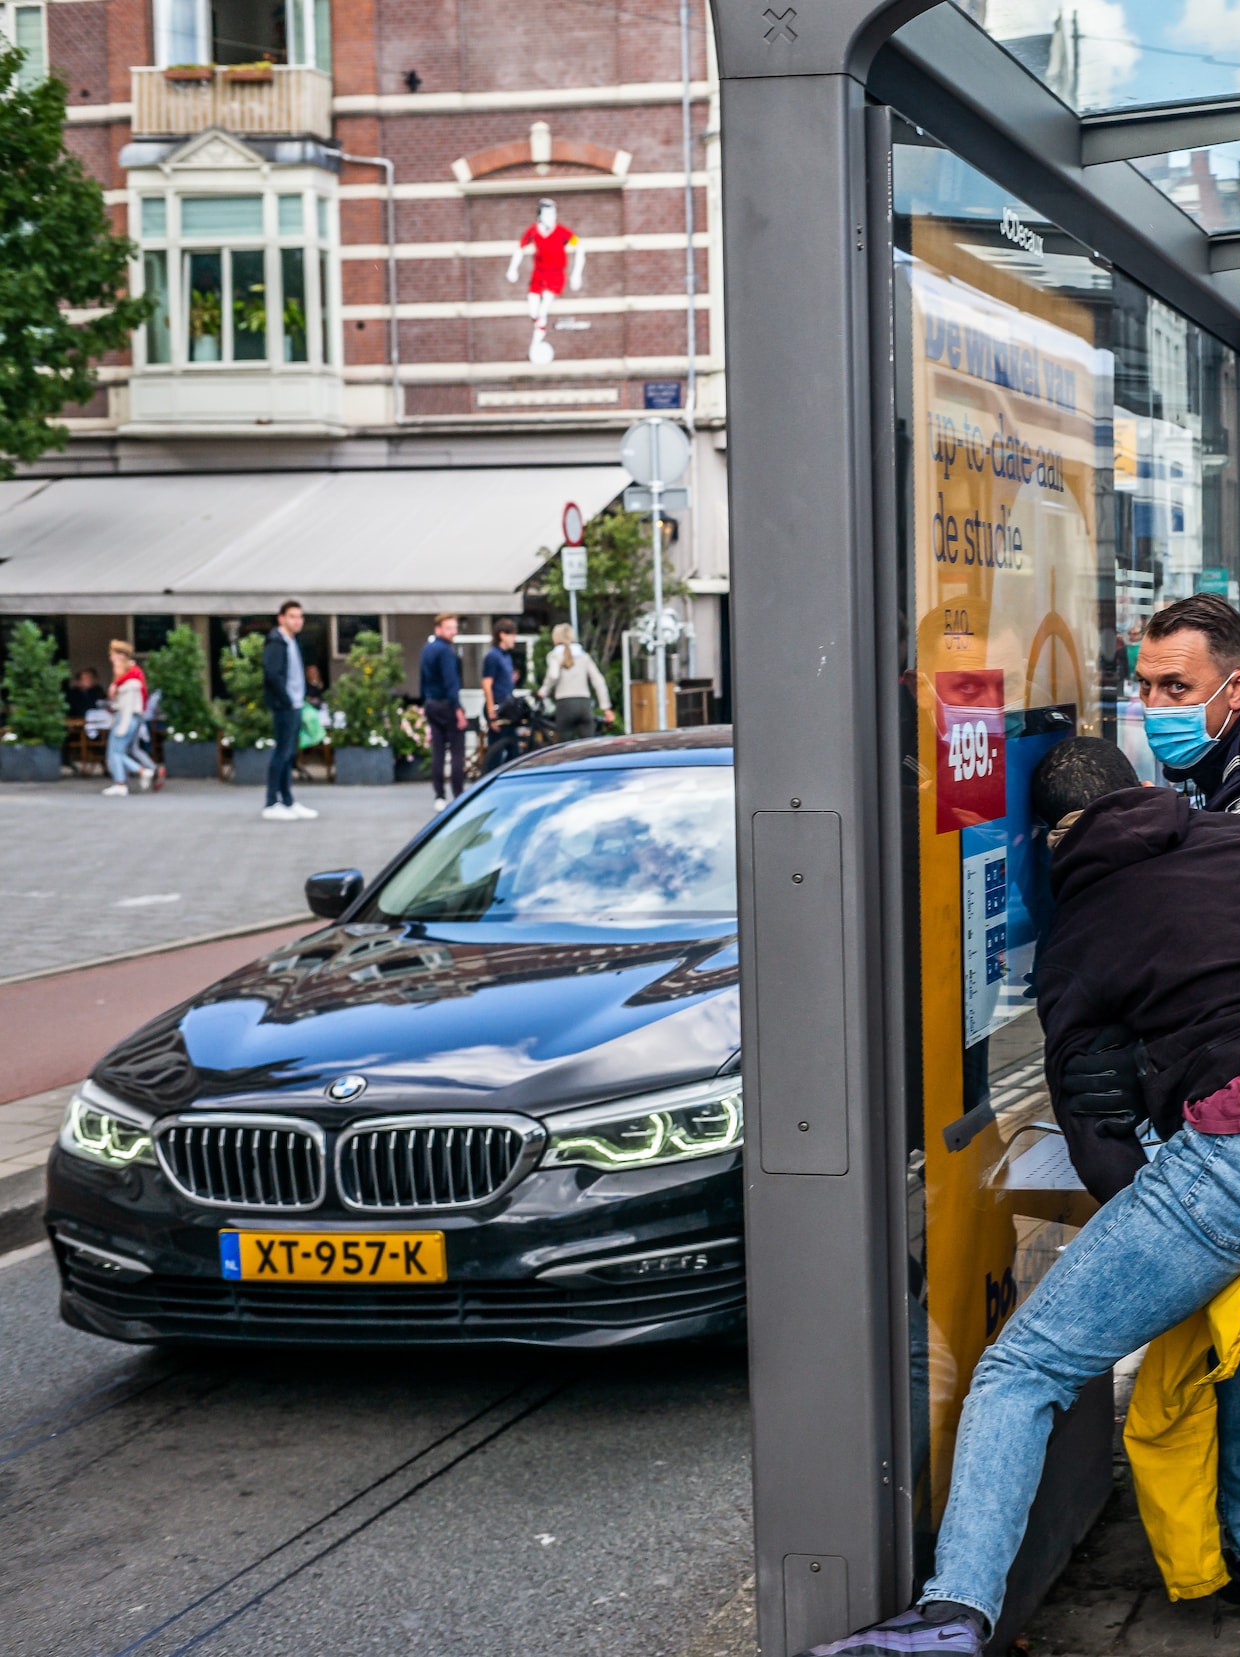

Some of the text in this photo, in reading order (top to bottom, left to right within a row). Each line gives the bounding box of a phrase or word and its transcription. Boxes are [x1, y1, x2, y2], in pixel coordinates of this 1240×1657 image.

[1000, 206, 1044, 258] JCDecaux
[925, 312, 1077, 414] De winkel van
[928, 411, 1065, 493] up-to-date aan
[933, 491, 1023, 570] de studie
[948, 720, 997, 782] 499,-
[255, 1240, 428, 1275] XT-957-K
